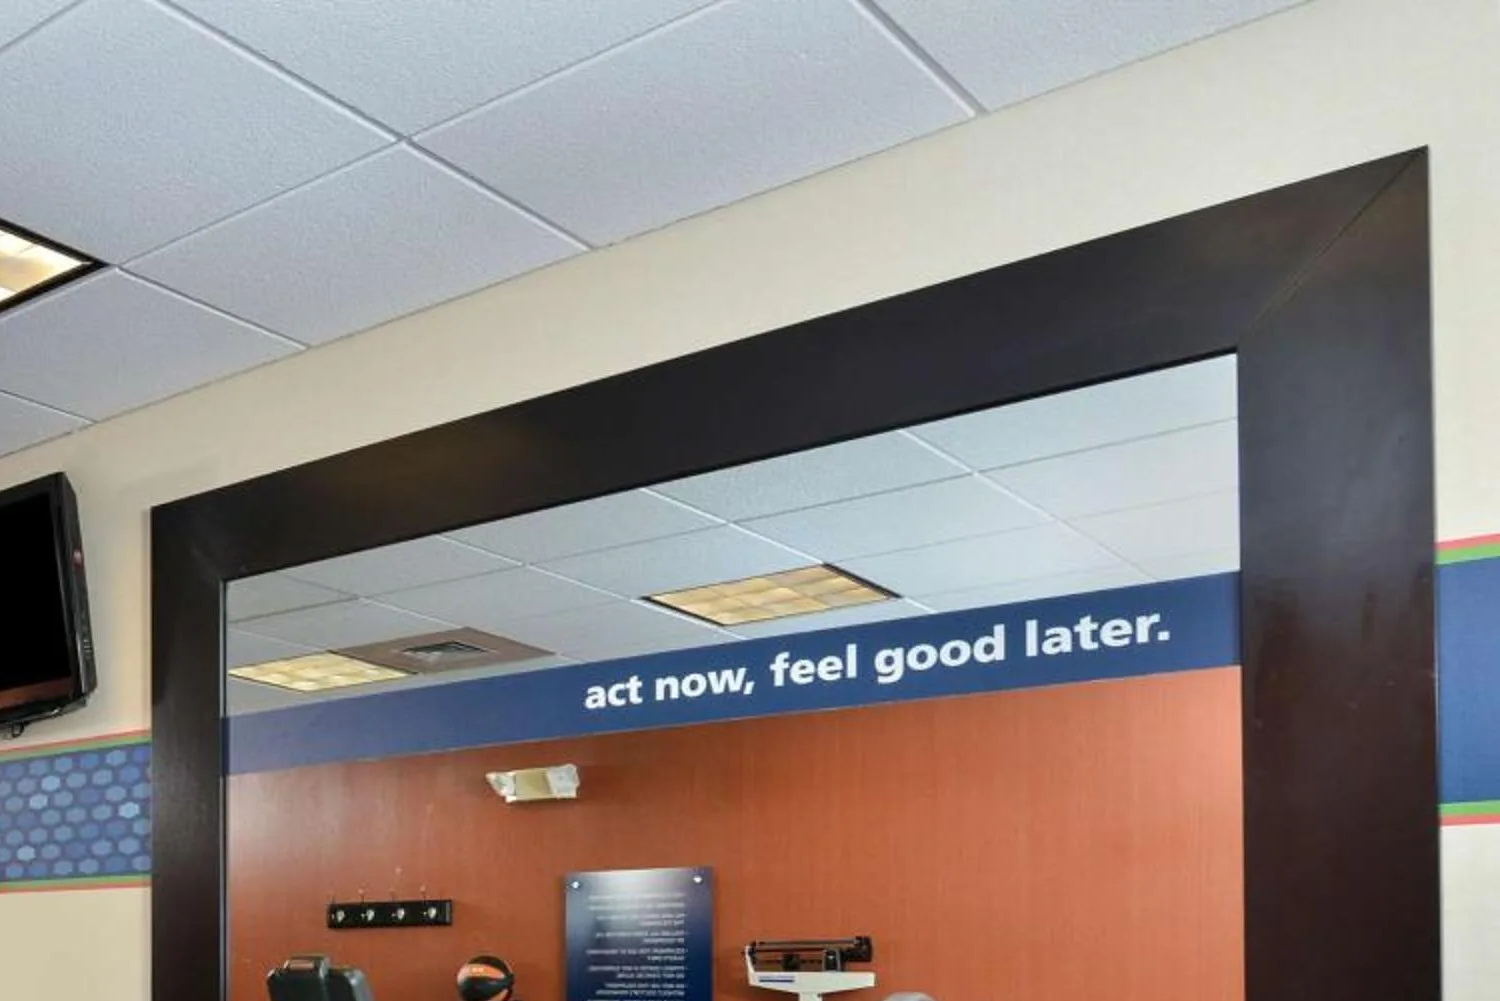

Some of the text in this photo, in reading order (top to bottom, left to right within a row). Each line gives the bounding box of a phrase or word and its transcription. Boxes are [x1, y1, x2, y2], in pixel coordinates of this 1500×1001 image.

[584, 612, 1171, 709] act now, feel good later.
